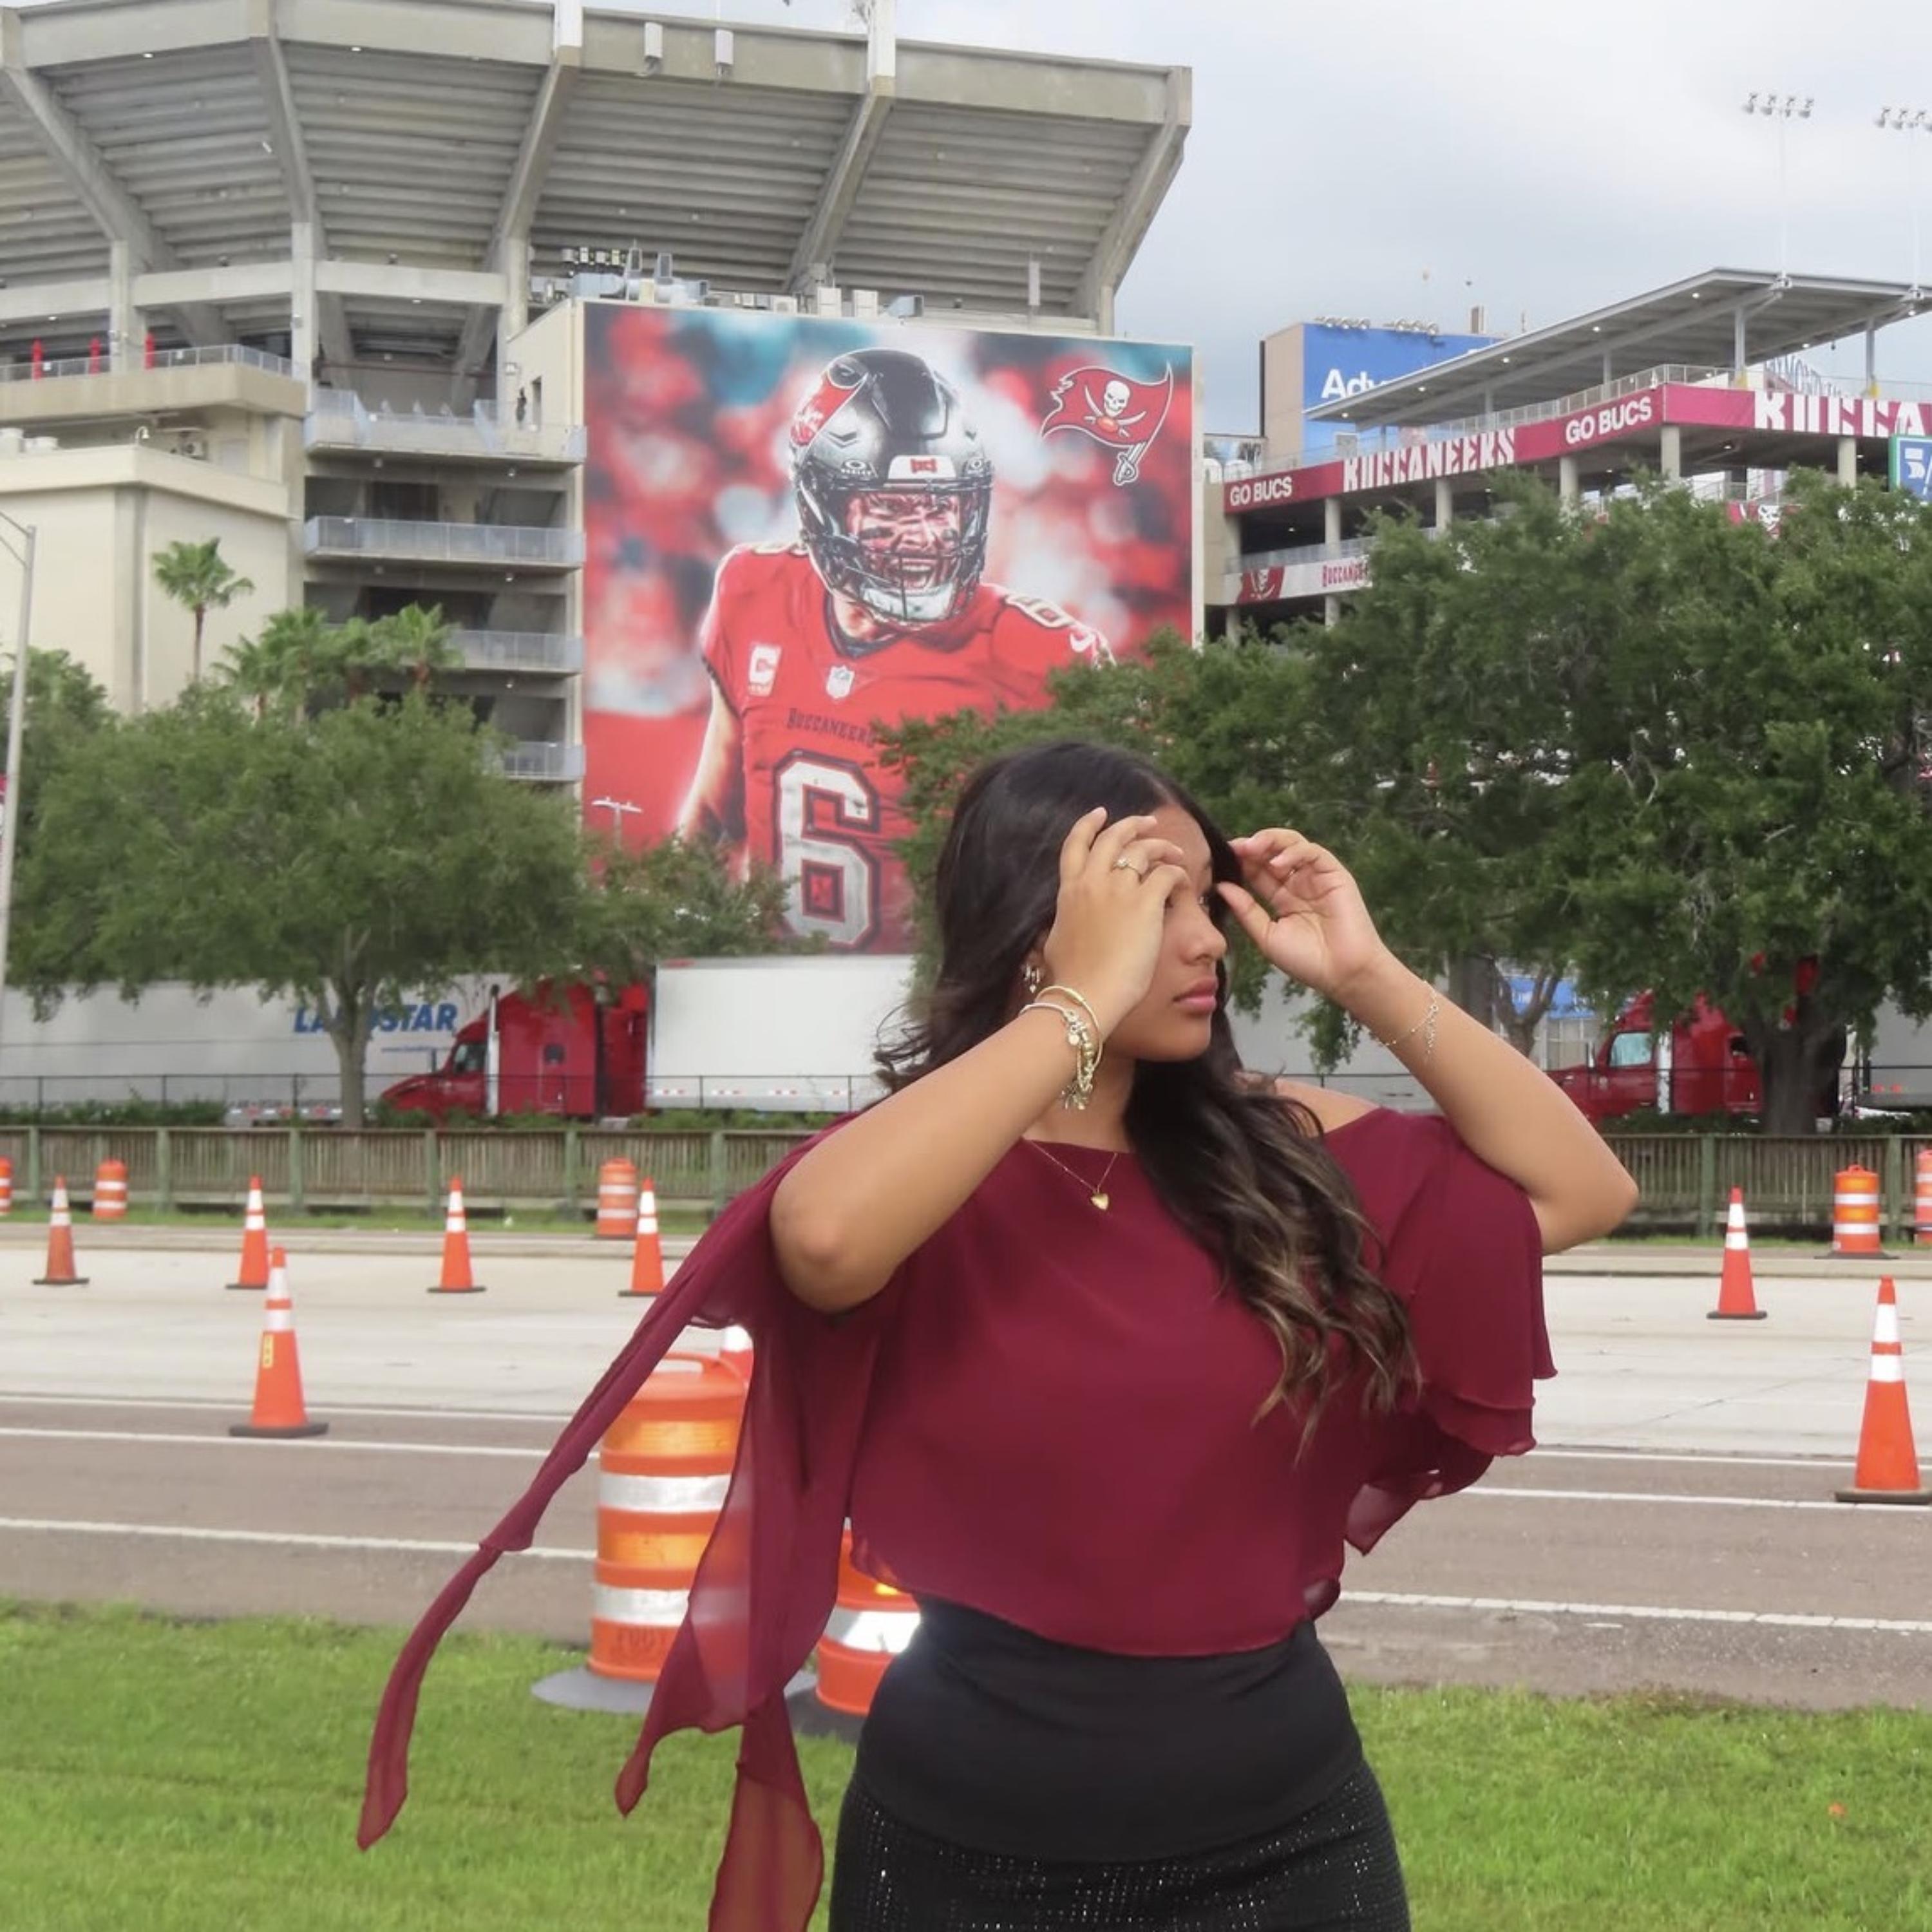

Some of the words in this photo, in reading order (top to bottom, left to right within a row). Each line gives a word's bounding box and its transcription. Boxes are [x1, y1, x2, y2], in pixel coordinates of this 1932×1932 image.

[1566, 415, 1595, 444] GO
[1598, 396, 1651, 435] BUCS
[1343, 426, 1515, 493] BUCCANEERS
[1230, 484, 1251, 506] GO
[1254, 477, 1292, 502] BUCS
[772, 748, 881, 956] 6
